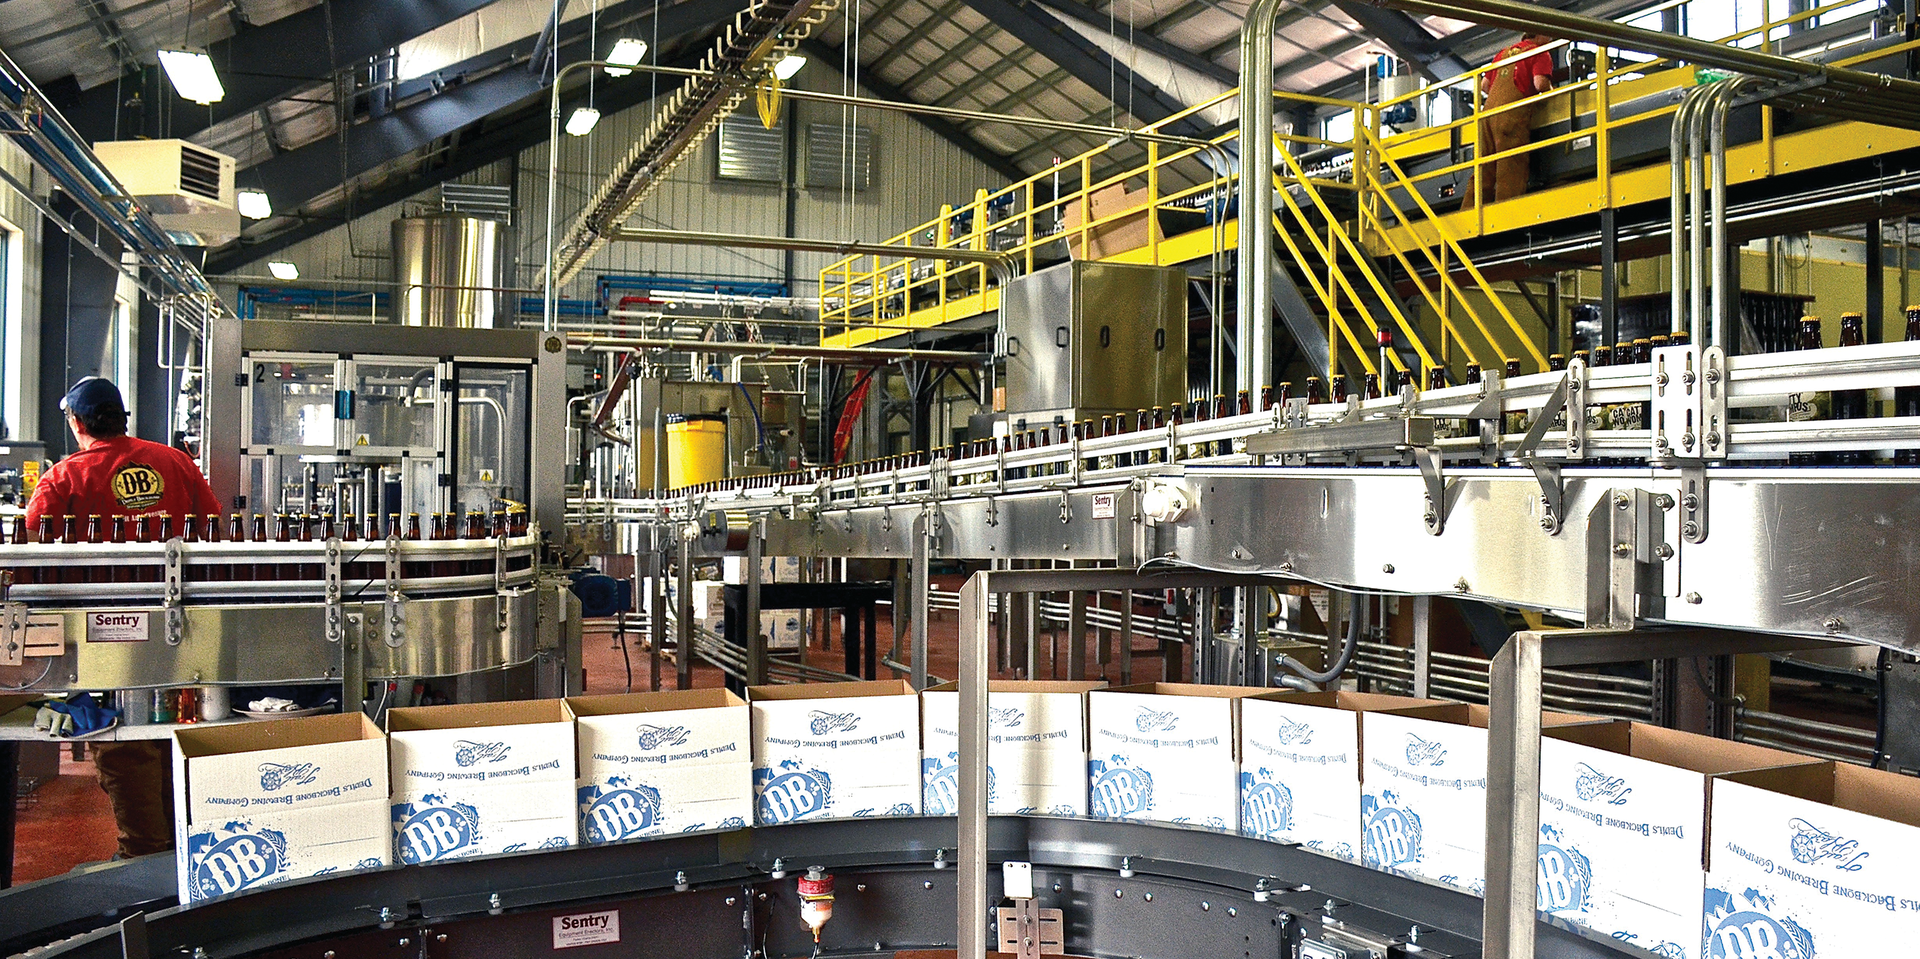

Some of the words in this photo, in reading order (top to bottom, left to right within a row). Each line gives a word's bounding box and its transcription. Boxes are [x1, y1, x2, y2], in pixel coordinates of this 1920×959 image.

[256, 364, 265, 382] 2
[122, 470, 151, 495] DB
[1095, 495, 1111, 507] Sentry
[95, 614, 140, 628] Sentry
[588, 792, 644, 841] DB
[762, 775, 815, 821] DB
[1095, 770, 1140, 818] DB
[1246, 786, 1282, 834] DB
[401, 810, 462, 861] DB
[1367, 811, 1410, 865] DB
[203, 838, 267, 891] DB
[561, 915, 609, 930] Sentry
